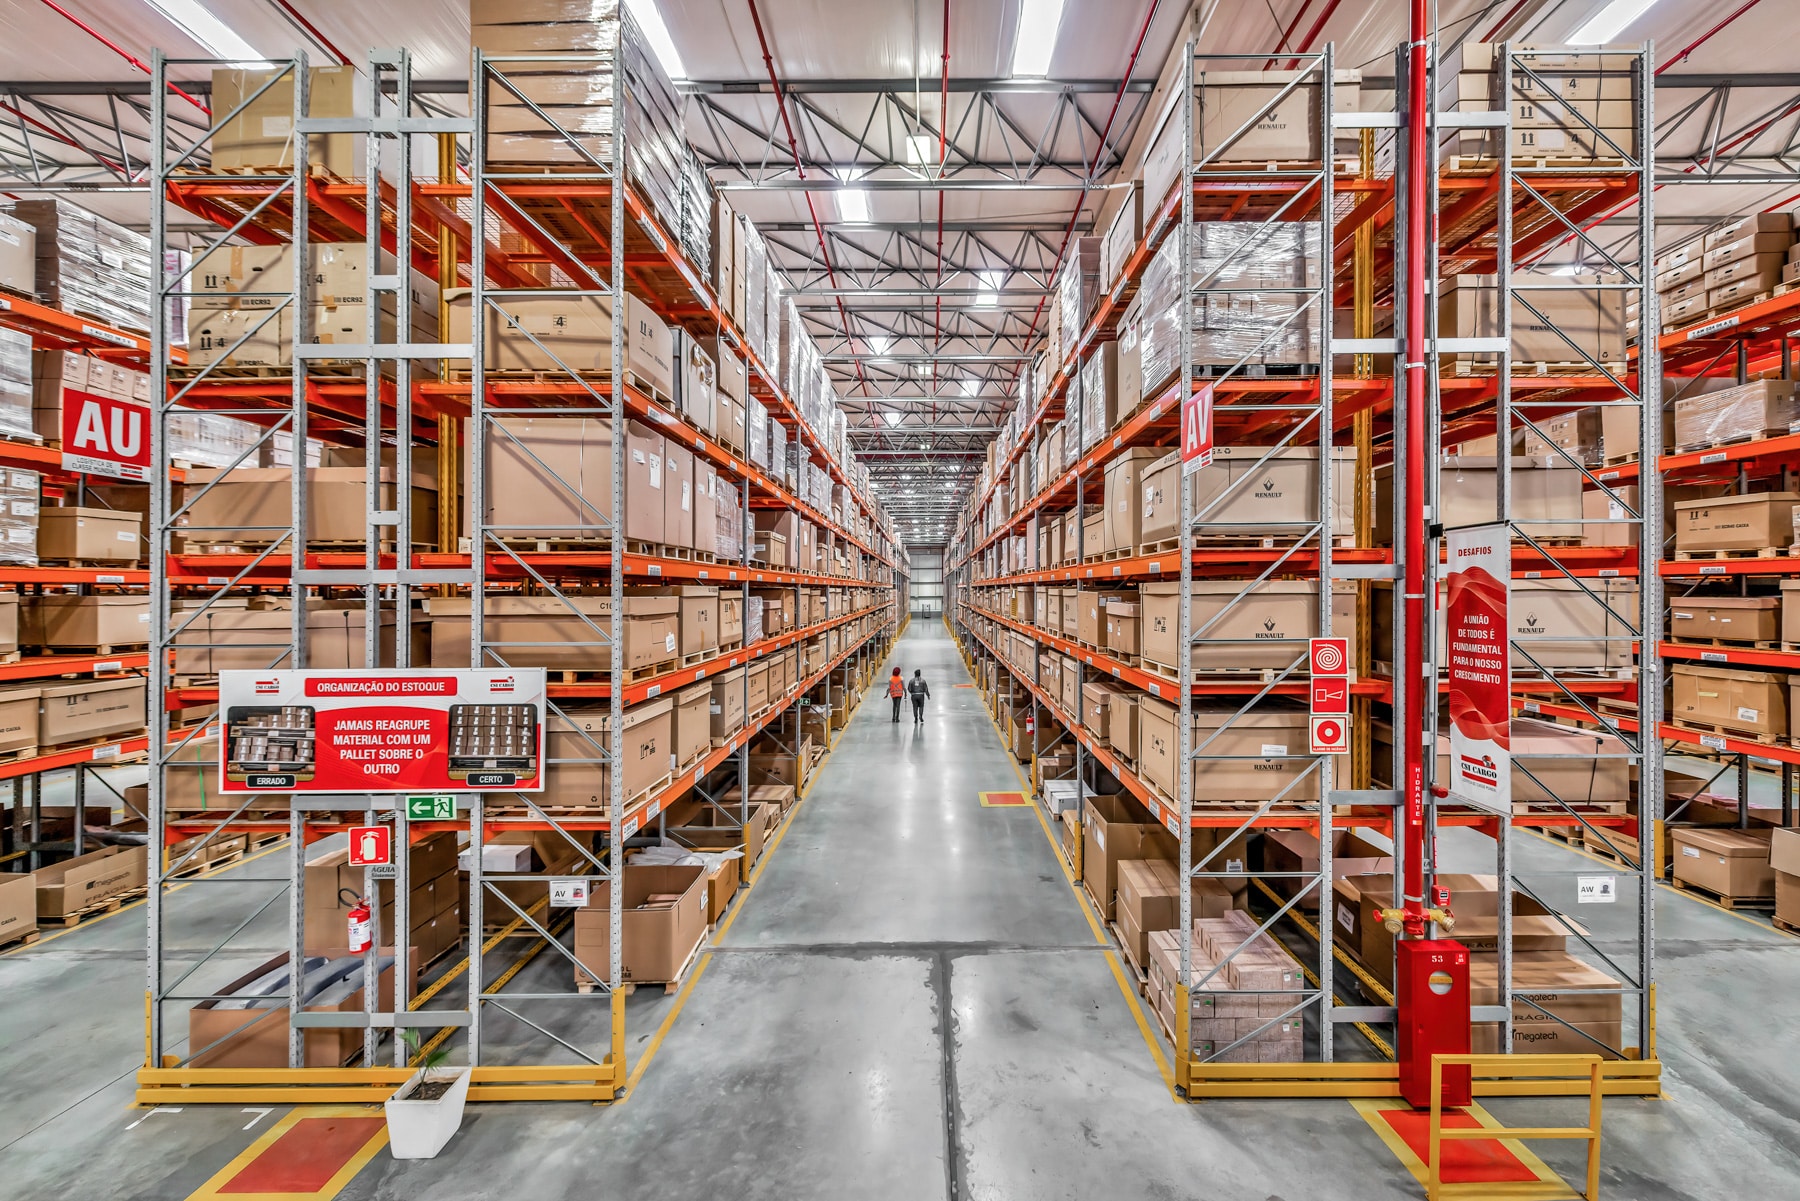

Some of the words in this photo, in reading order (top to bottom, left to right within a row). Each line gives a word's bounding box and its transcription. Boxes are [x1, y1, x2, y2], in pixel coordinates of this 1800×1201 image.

[556, 316, 564, 327] 4
[73, 400, 142, 458] AU
[1186, 394, 1211, 454] AV
[1458, 546, 1492, 557] DESAFIOS
[1463, 615, 1468, 625] A
[1468, 614, 1489, 625] UNIÃO
[1458, 629, 1466, 638] DE
[1467, 631, 1488, 639] TODOS
[1490, 628, 1495, 640] É
[1453, 641, 1502, 655] FUNDAMENTAL
[1453, 655, 1469, 667] PARA
[1469, 658, 1474, 667] O
[1474, 658, 1502, 670] NOSSO
[1454, 669, 1501, 685] CRESCIMENTO
[317, 681, 384, 694] ORGANIZAÇÃO
[385, 682, 400, 692] DO
[401, 681, 445, 693] ESTOQUE
[333, 720, 373, 731] JAMAIS
[375, 719, 430, 730] REAGRUPE
[333, 735, 384, 745] MATERIAL
[386, 734, 411, 745] COM
[413, 734, 431, 745] UM
[340, 750, 377, 760] PALLET
[378, 749, 413, 760] SOBRE
[415, 749, 424, 759] O
[363, 763, 400, 774] OUTRO
[1461, 762, 1472, 772] CSI
[1472, 765, 1498, 779] CARGO
[256, 777, 287, 785] ERRADO
[478, 774, 503, 783] CERTO
[554, 890, 566, 898] AV
[1580, 885, 1595, 894] AW
[1431, 955, 1444, 964] 53
